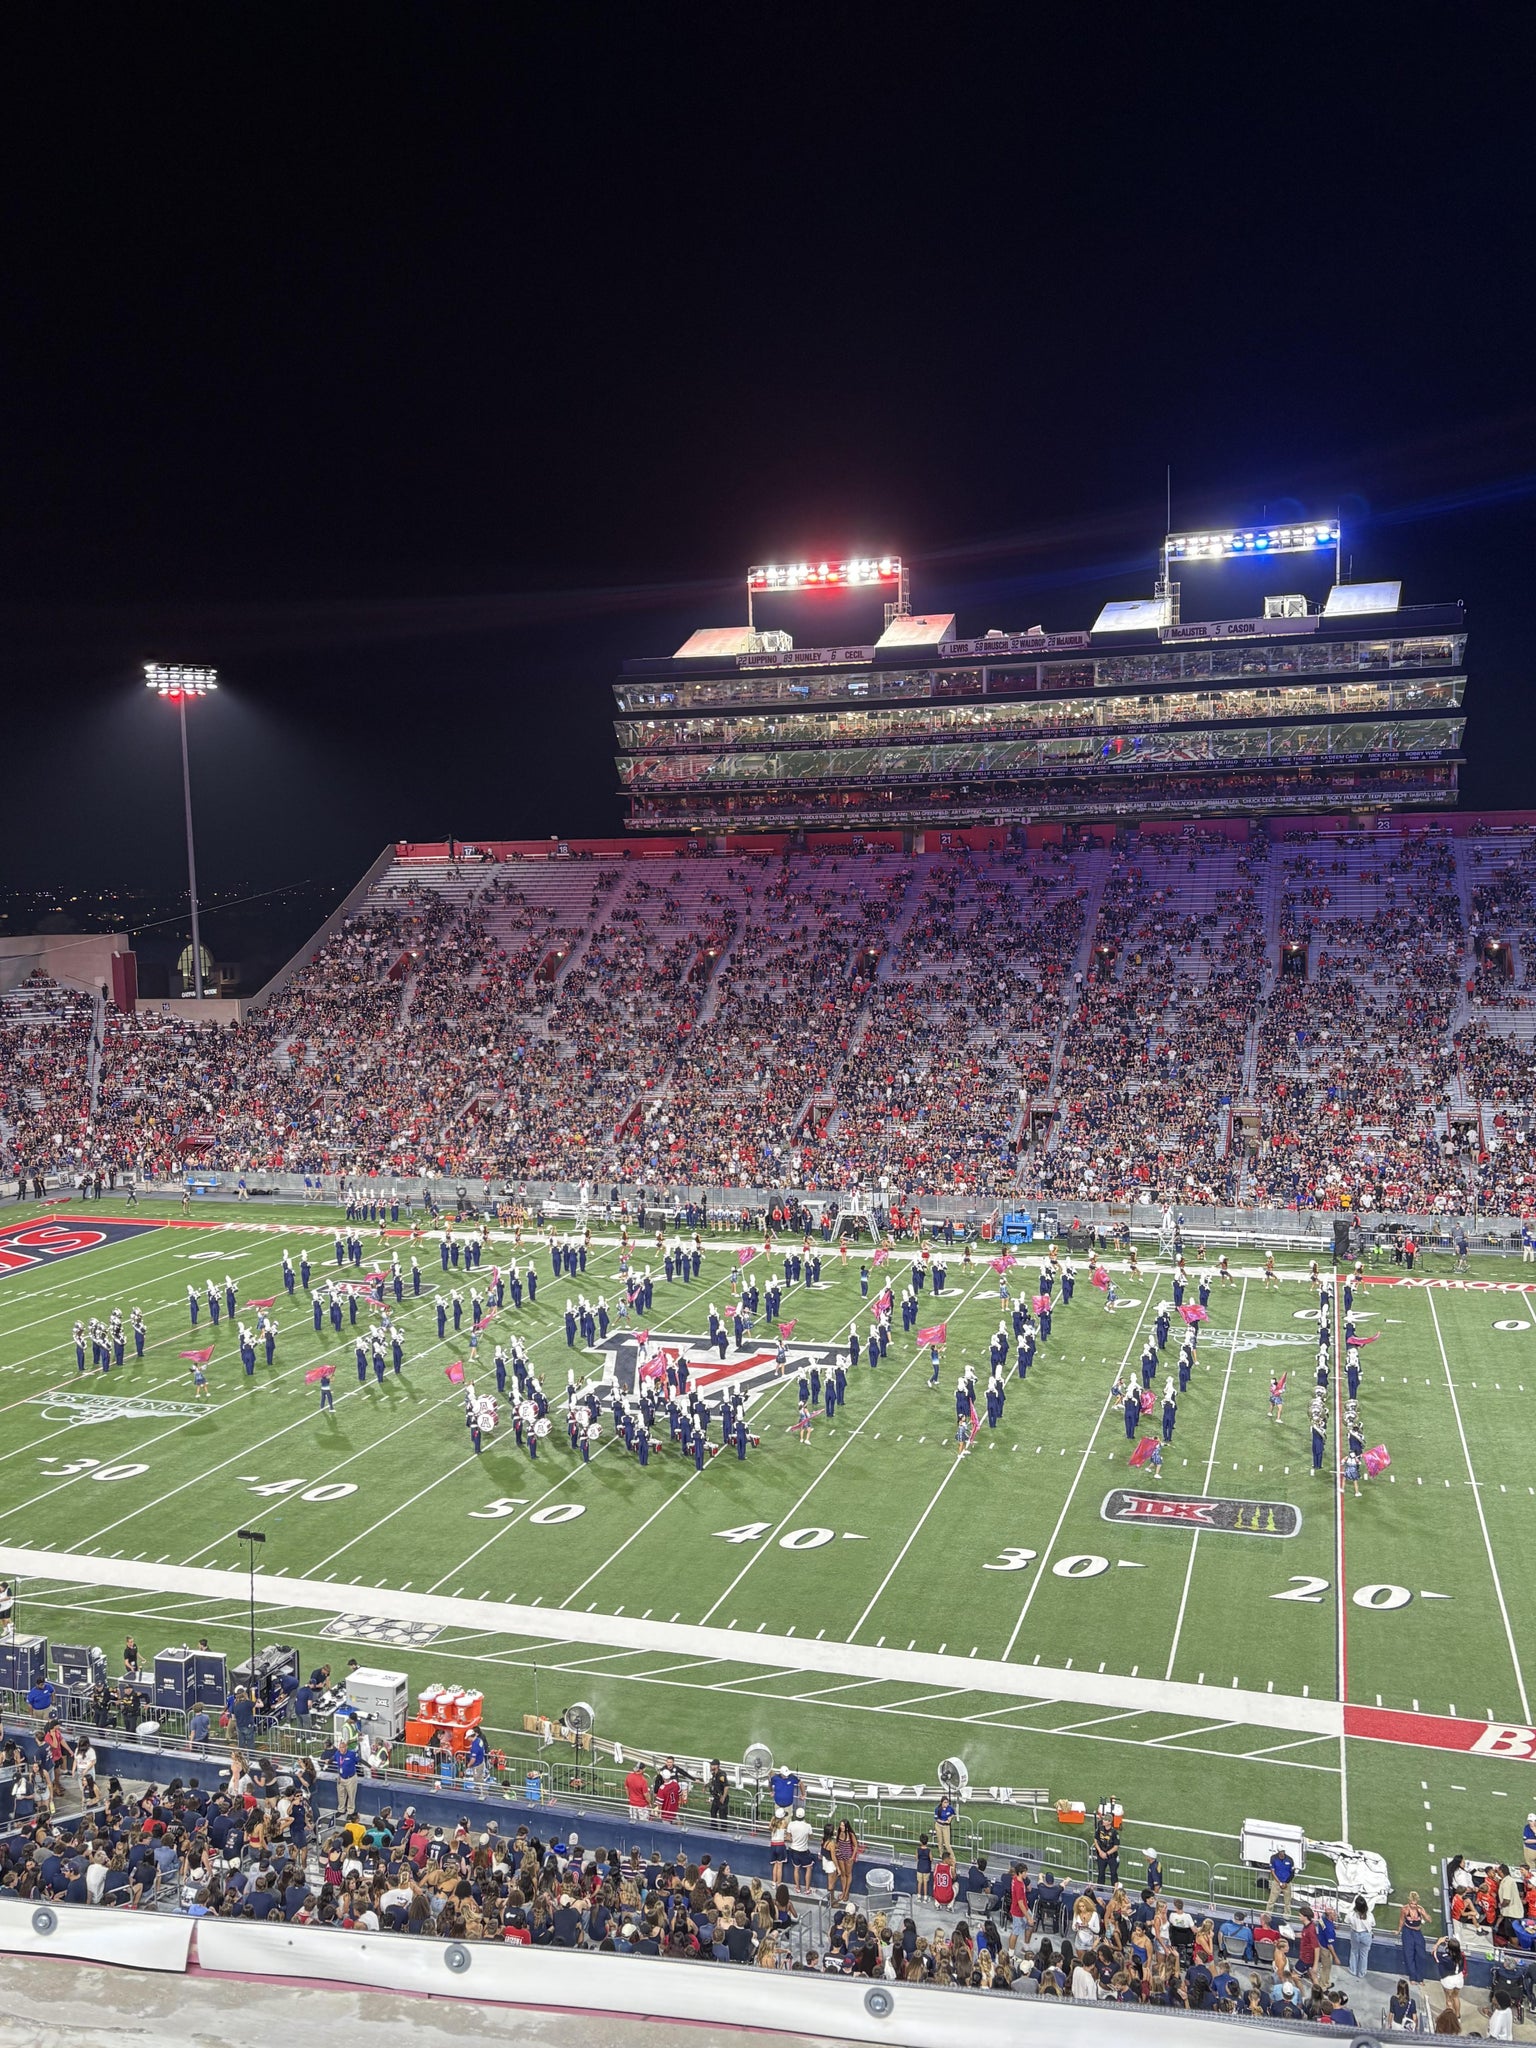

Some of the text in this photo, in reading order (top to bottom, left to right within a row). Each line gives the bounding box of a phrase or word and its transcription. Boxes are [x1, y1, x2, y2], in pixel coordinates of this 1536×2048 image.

[1172, 627, 1207, 637] McALISTER
[1215, 624, 1255, 634] 5 CASON
[984, 642, 1008, 650] BRUSCHI
[1020, 638, 1045, 647] WALDROP
[950, 644, 969, 652] LEWIS
[739, 655, 777, 665] 22 LUPPINO
[795, 653, 821, 661] HUNLEY
[831, 651, 864, 660] 6 CECIL
[1377, 821, 1390, 830] 23
[941, 836, 951, 844] 21
[559, 846, 568, 854] 18
[41, 1393, 211, 1414] CASINO DEL SOL
[40, 1458, 150, 1481] 30
[247, 1478, 360, 1502] 40
[468, 1498, 586, 1525] 50
[710, 1522, 836, 1550] 40
[981, 1547, 1109, 1578] 30
[1268, 1575, 1413, 1610] 20
[420, 1703, 427, 1711] G
[438, 1706, 445, 1714] G
[457, 1708, 465, 1716] G
[935, 1873, 948, 1887] 13
